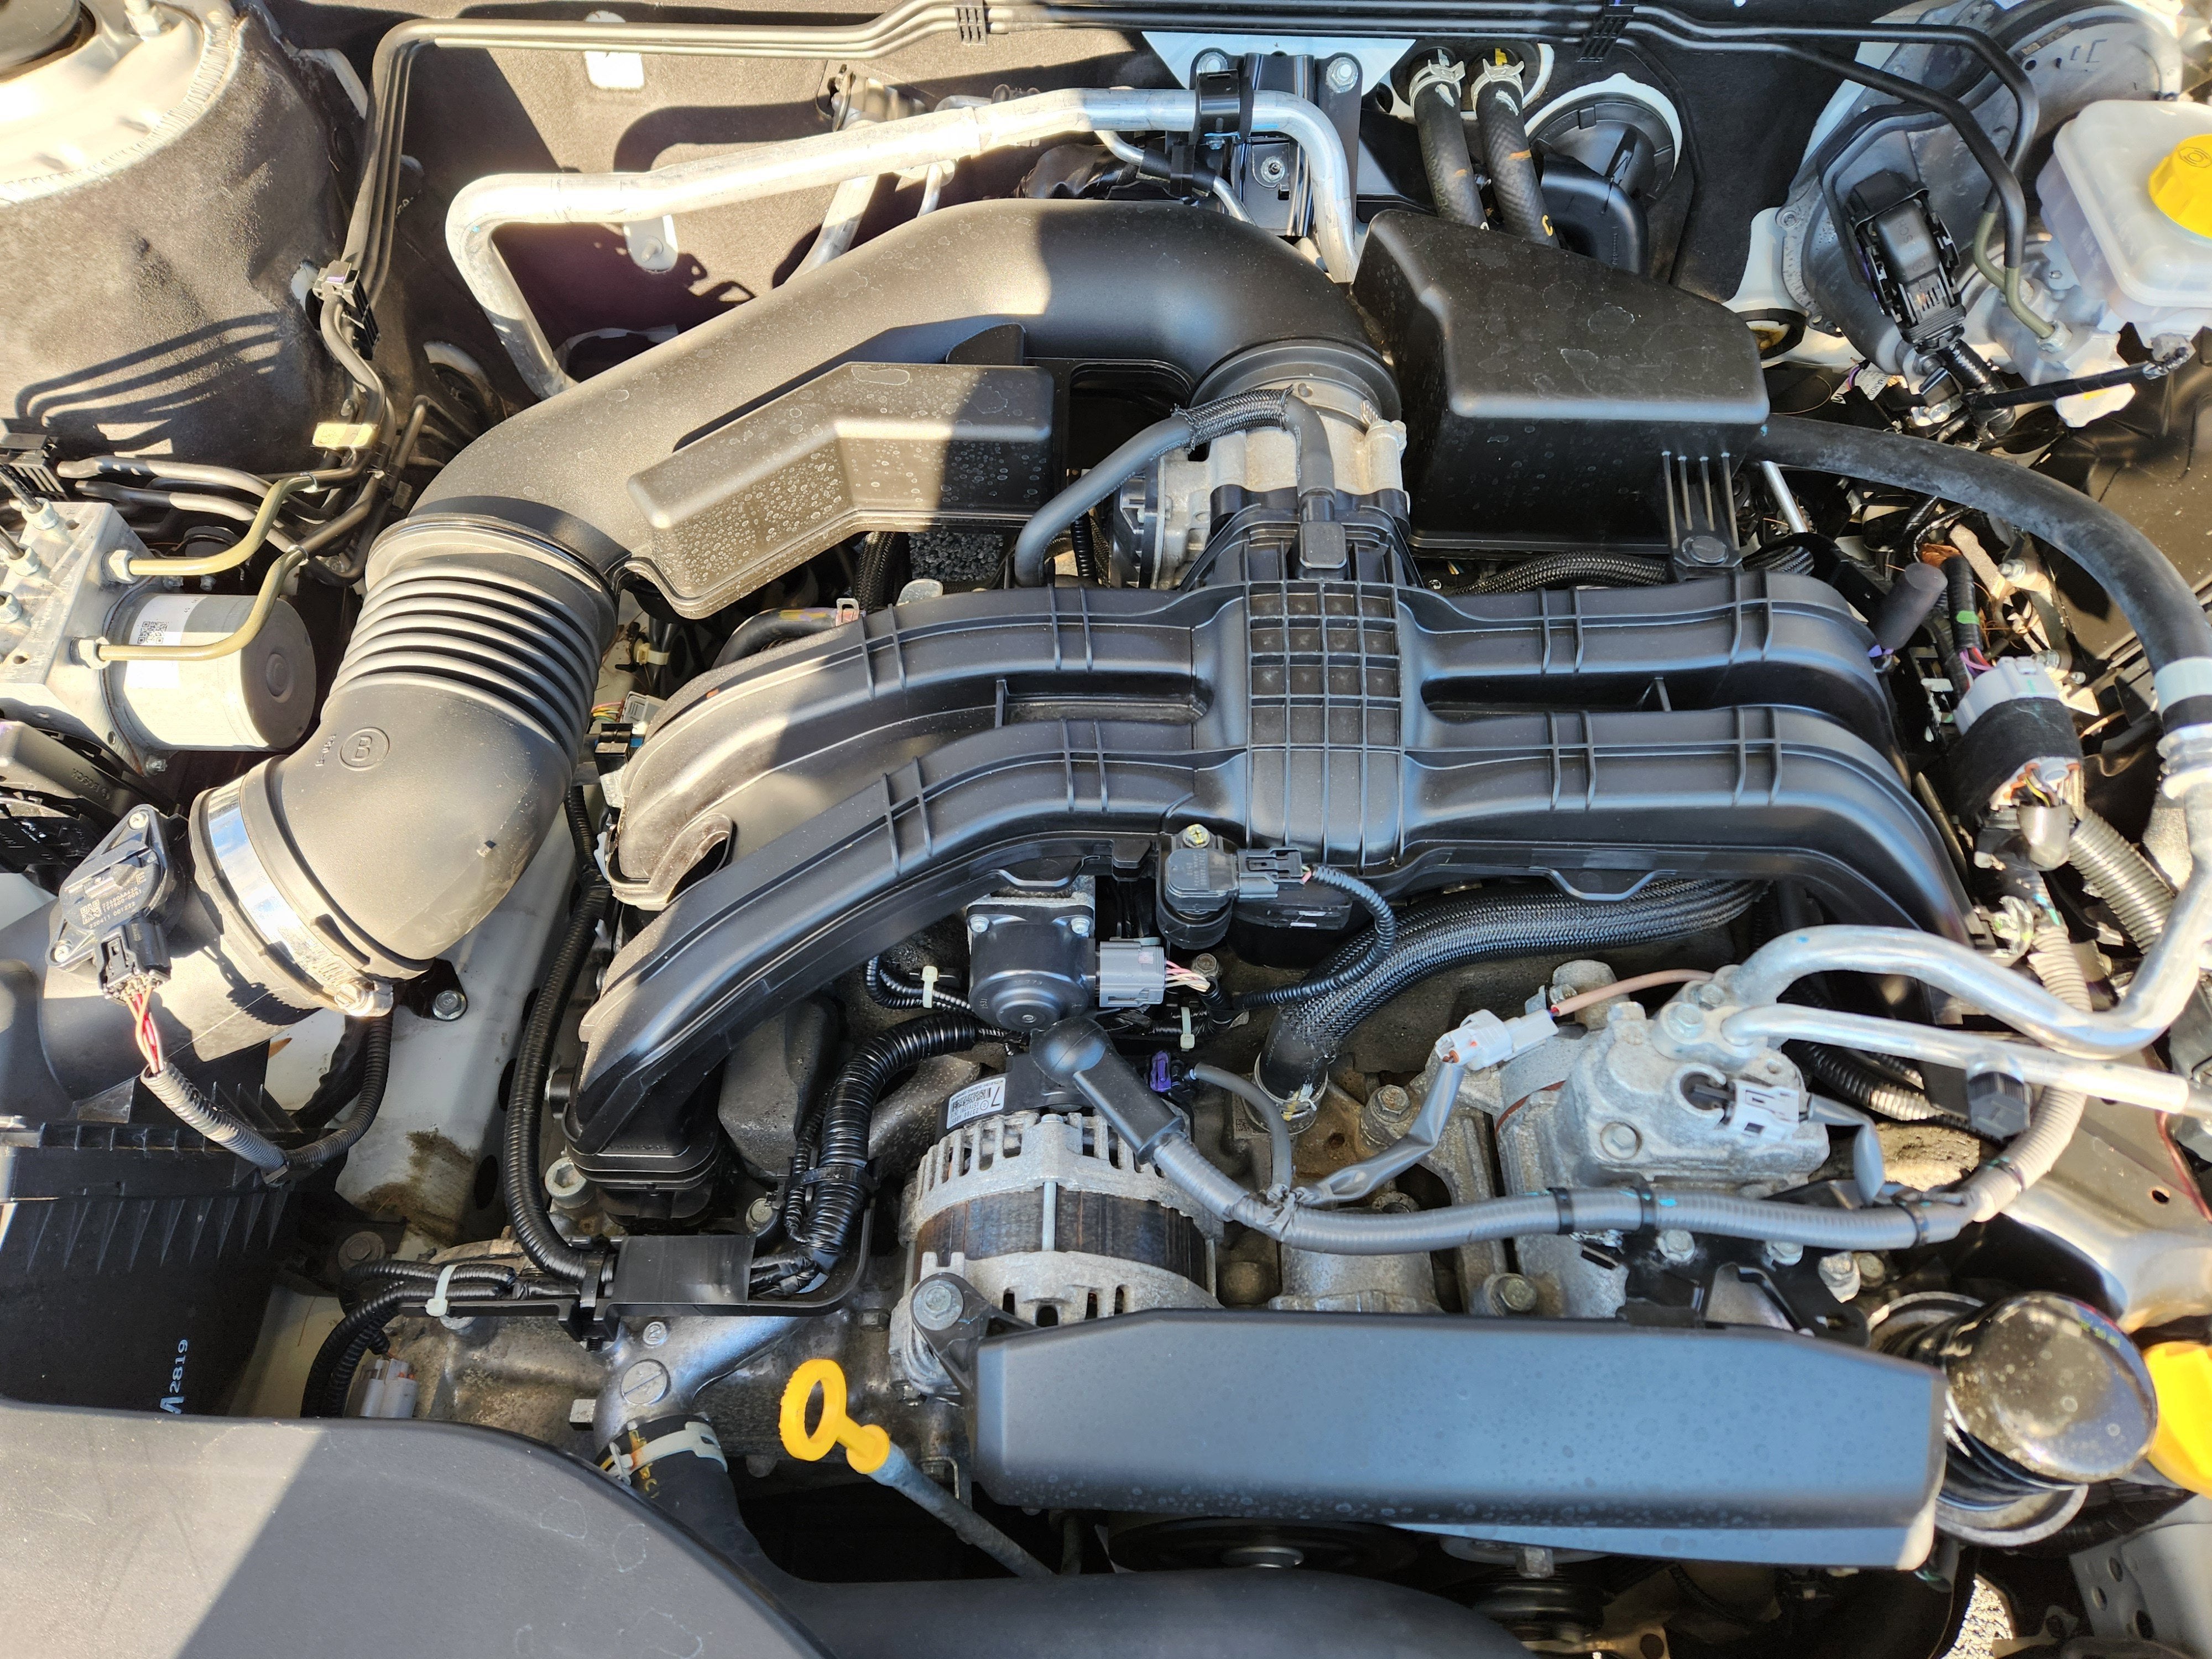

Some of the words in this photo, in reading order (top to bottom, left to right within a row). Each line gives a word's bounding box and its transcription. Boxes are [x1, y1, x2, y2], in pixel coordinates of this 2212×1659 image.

[351, 734, 373, 763] B
[72, 768, 100, 793] BOSCH
[135, 872, 147, 885] E
[113, 901, 136, 916] 001222
[990, 1086, 1001, 1108] 7
[169, 1339, 189, 1394] 2819
